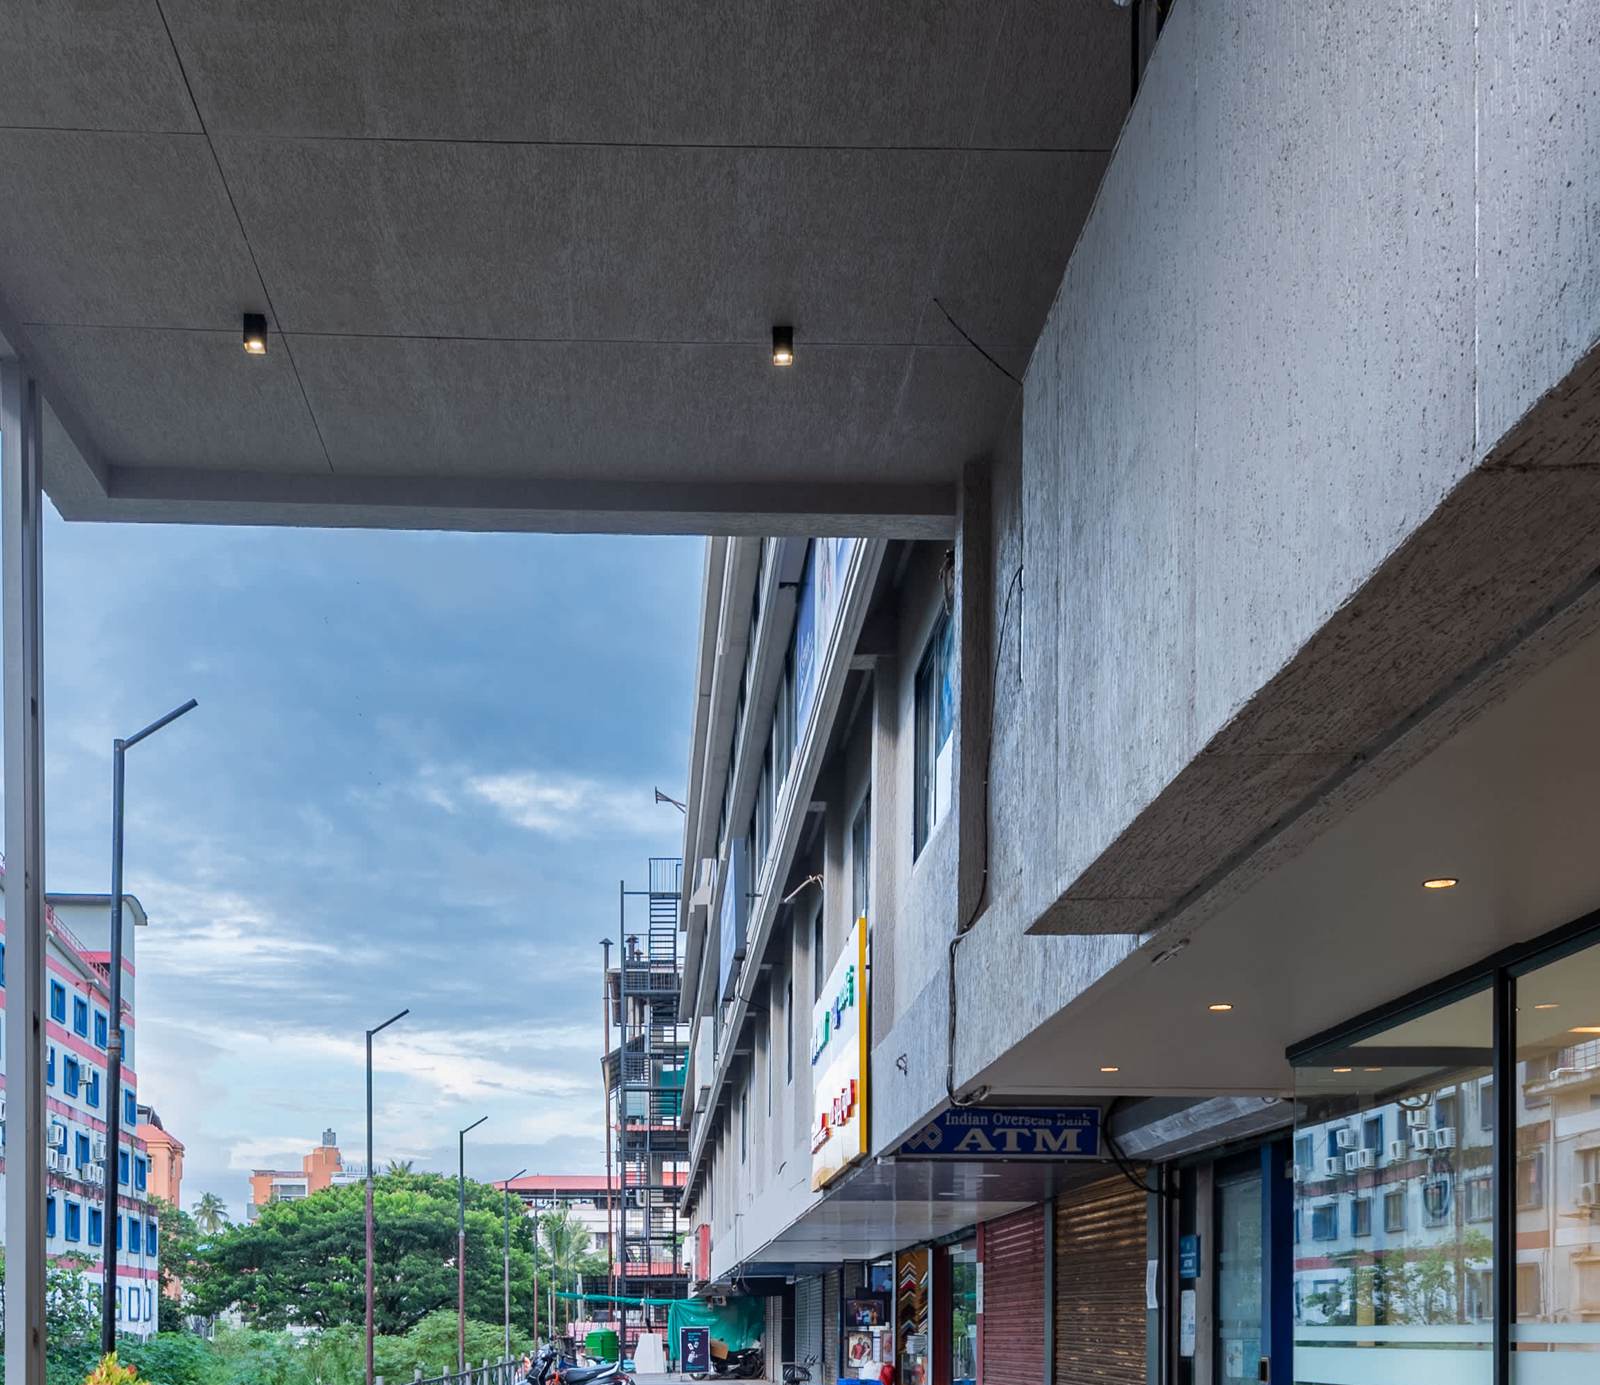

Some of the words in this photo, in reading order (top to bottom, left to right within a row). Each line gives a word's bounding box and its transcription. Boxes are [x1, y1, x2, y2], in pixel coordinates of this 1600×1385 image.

[945, 1112, 988, 1126] Indian
[992, 1113, 1052, 1126] Overseas
[953, 1127, 1083, 1152] ATM
